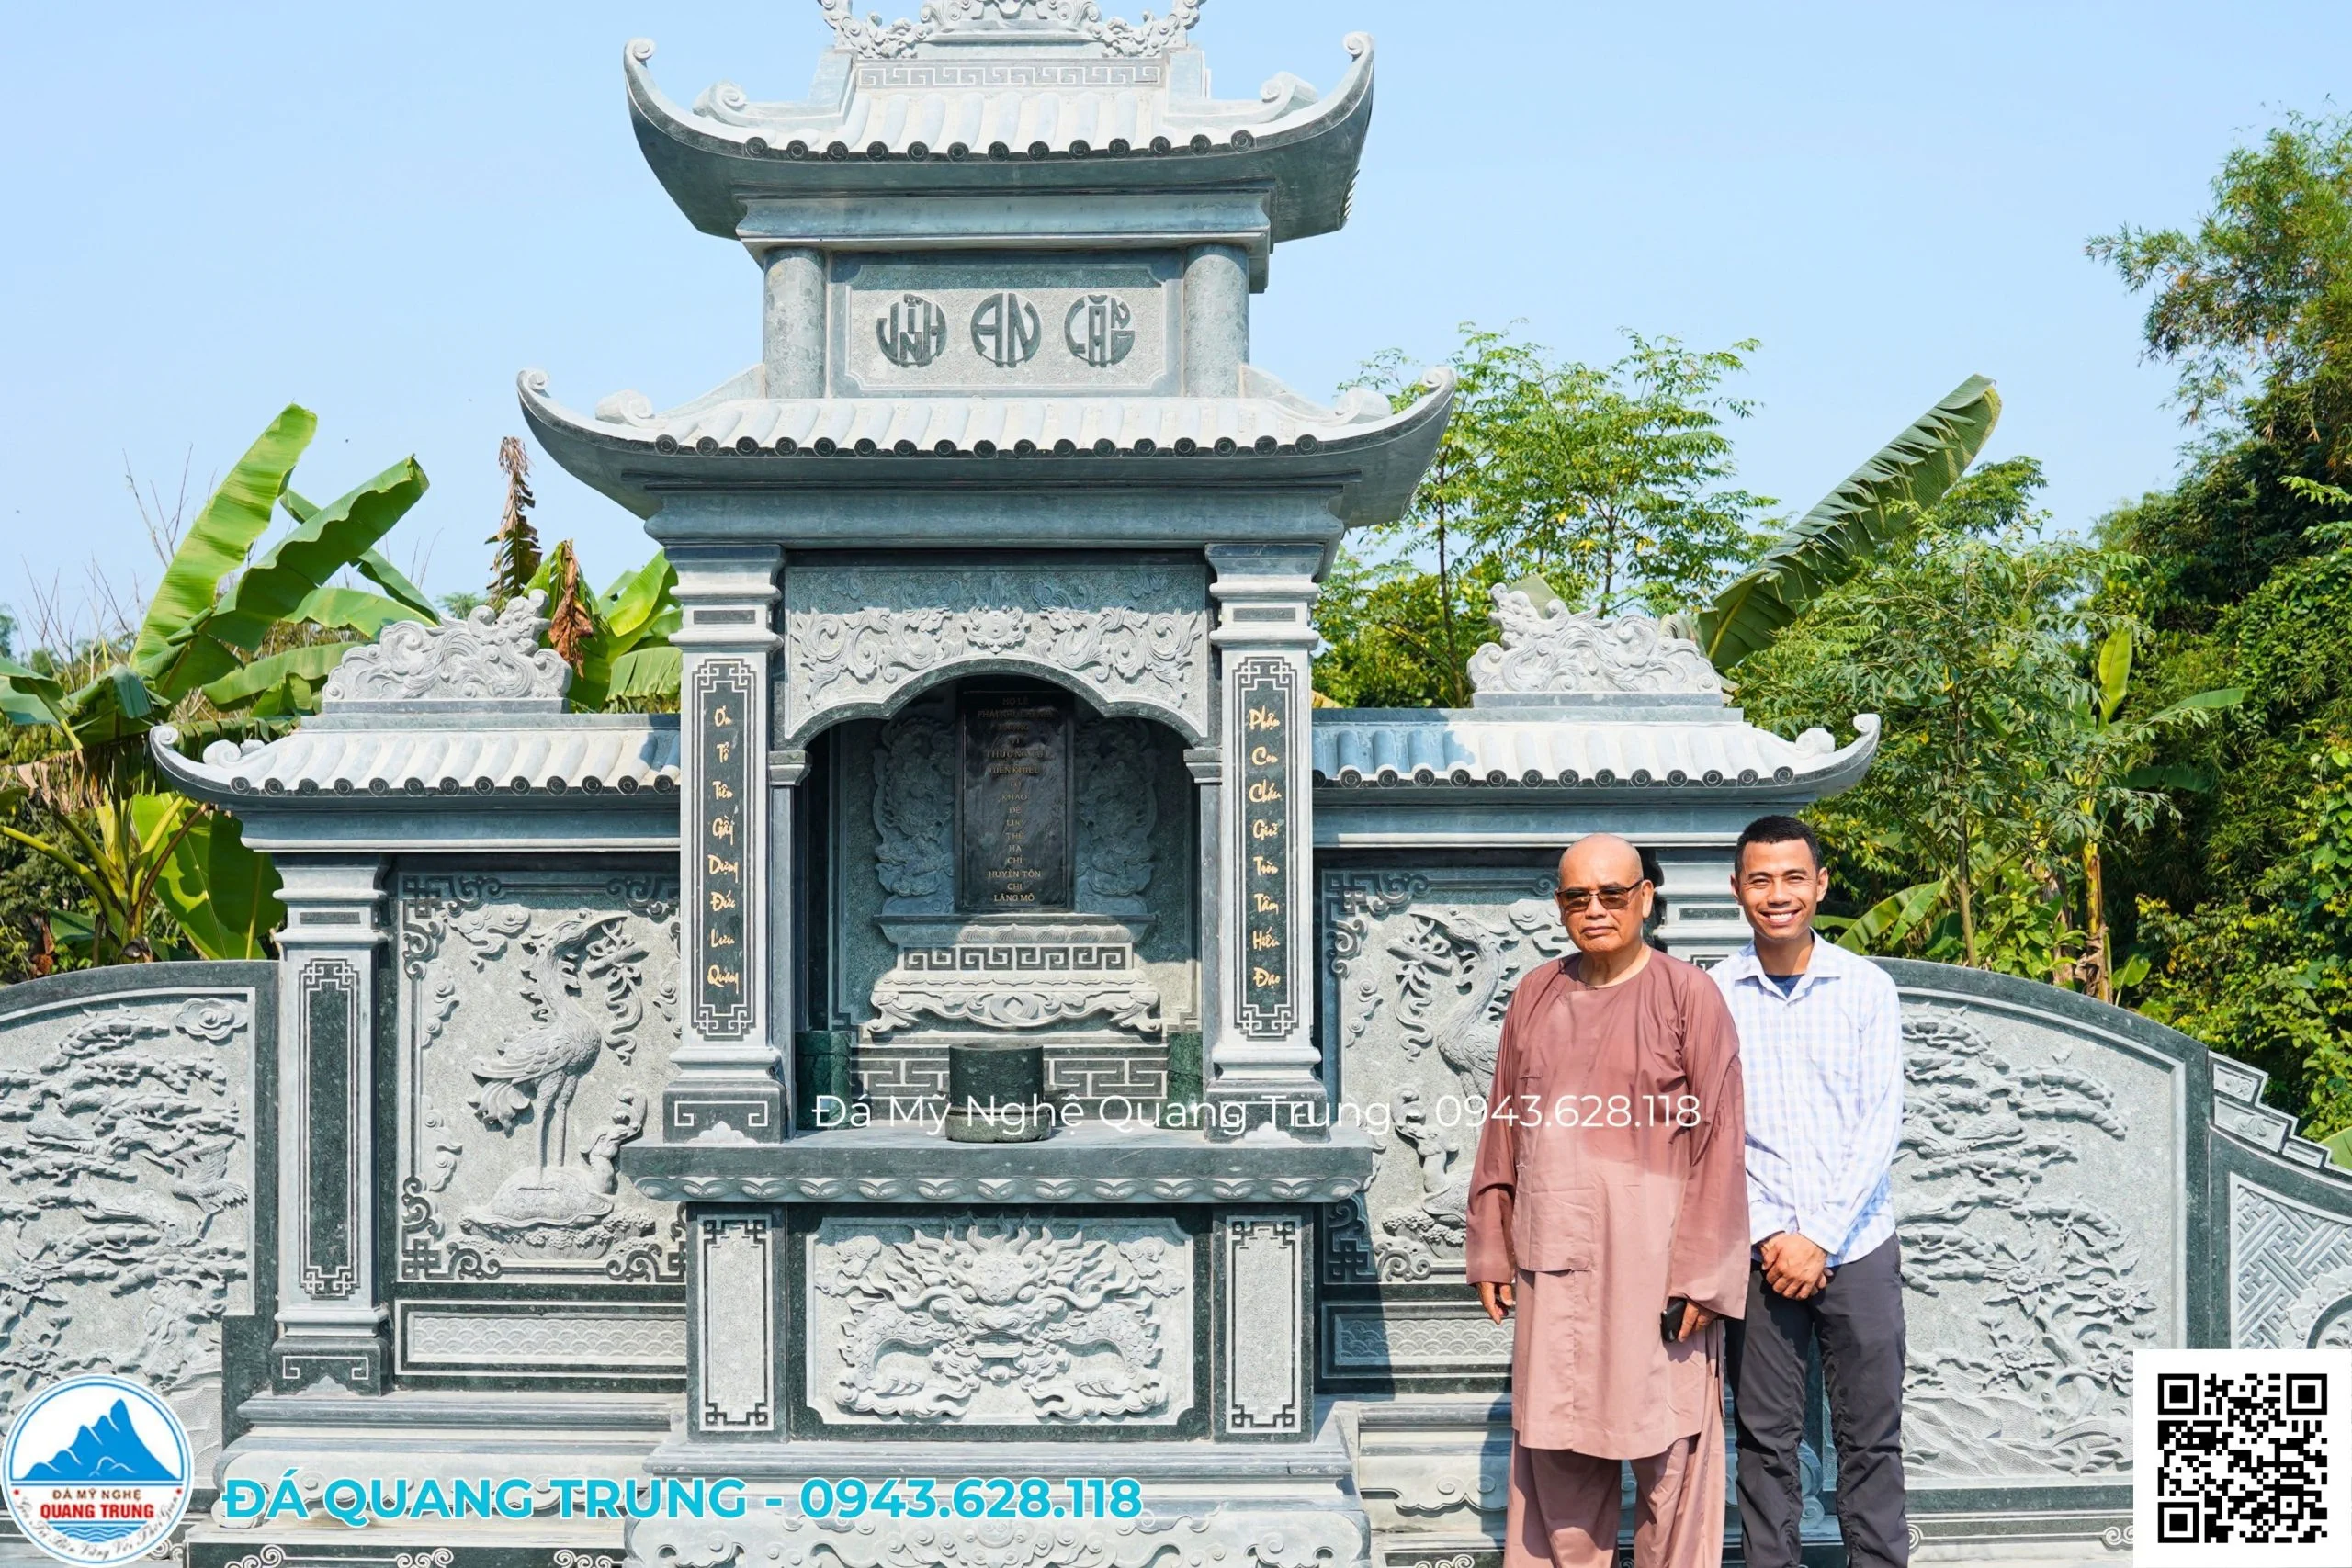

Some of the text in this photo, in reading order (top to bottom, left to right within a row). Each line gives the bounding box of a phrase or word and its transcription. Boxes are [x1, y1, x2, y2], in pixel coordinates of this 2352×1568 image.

[970, 293, 1042, 368] AN
[717, 741, 729, 763] Tổ
[712, 780, 733, 801] Tiên
[1249, 778, 1283, 803] Cháu
[1253, 893, 1280, 915] Tâm
[1252, 926, 1281, 952] Hiếu
[1253, 967, 1281, 989] Đạo
